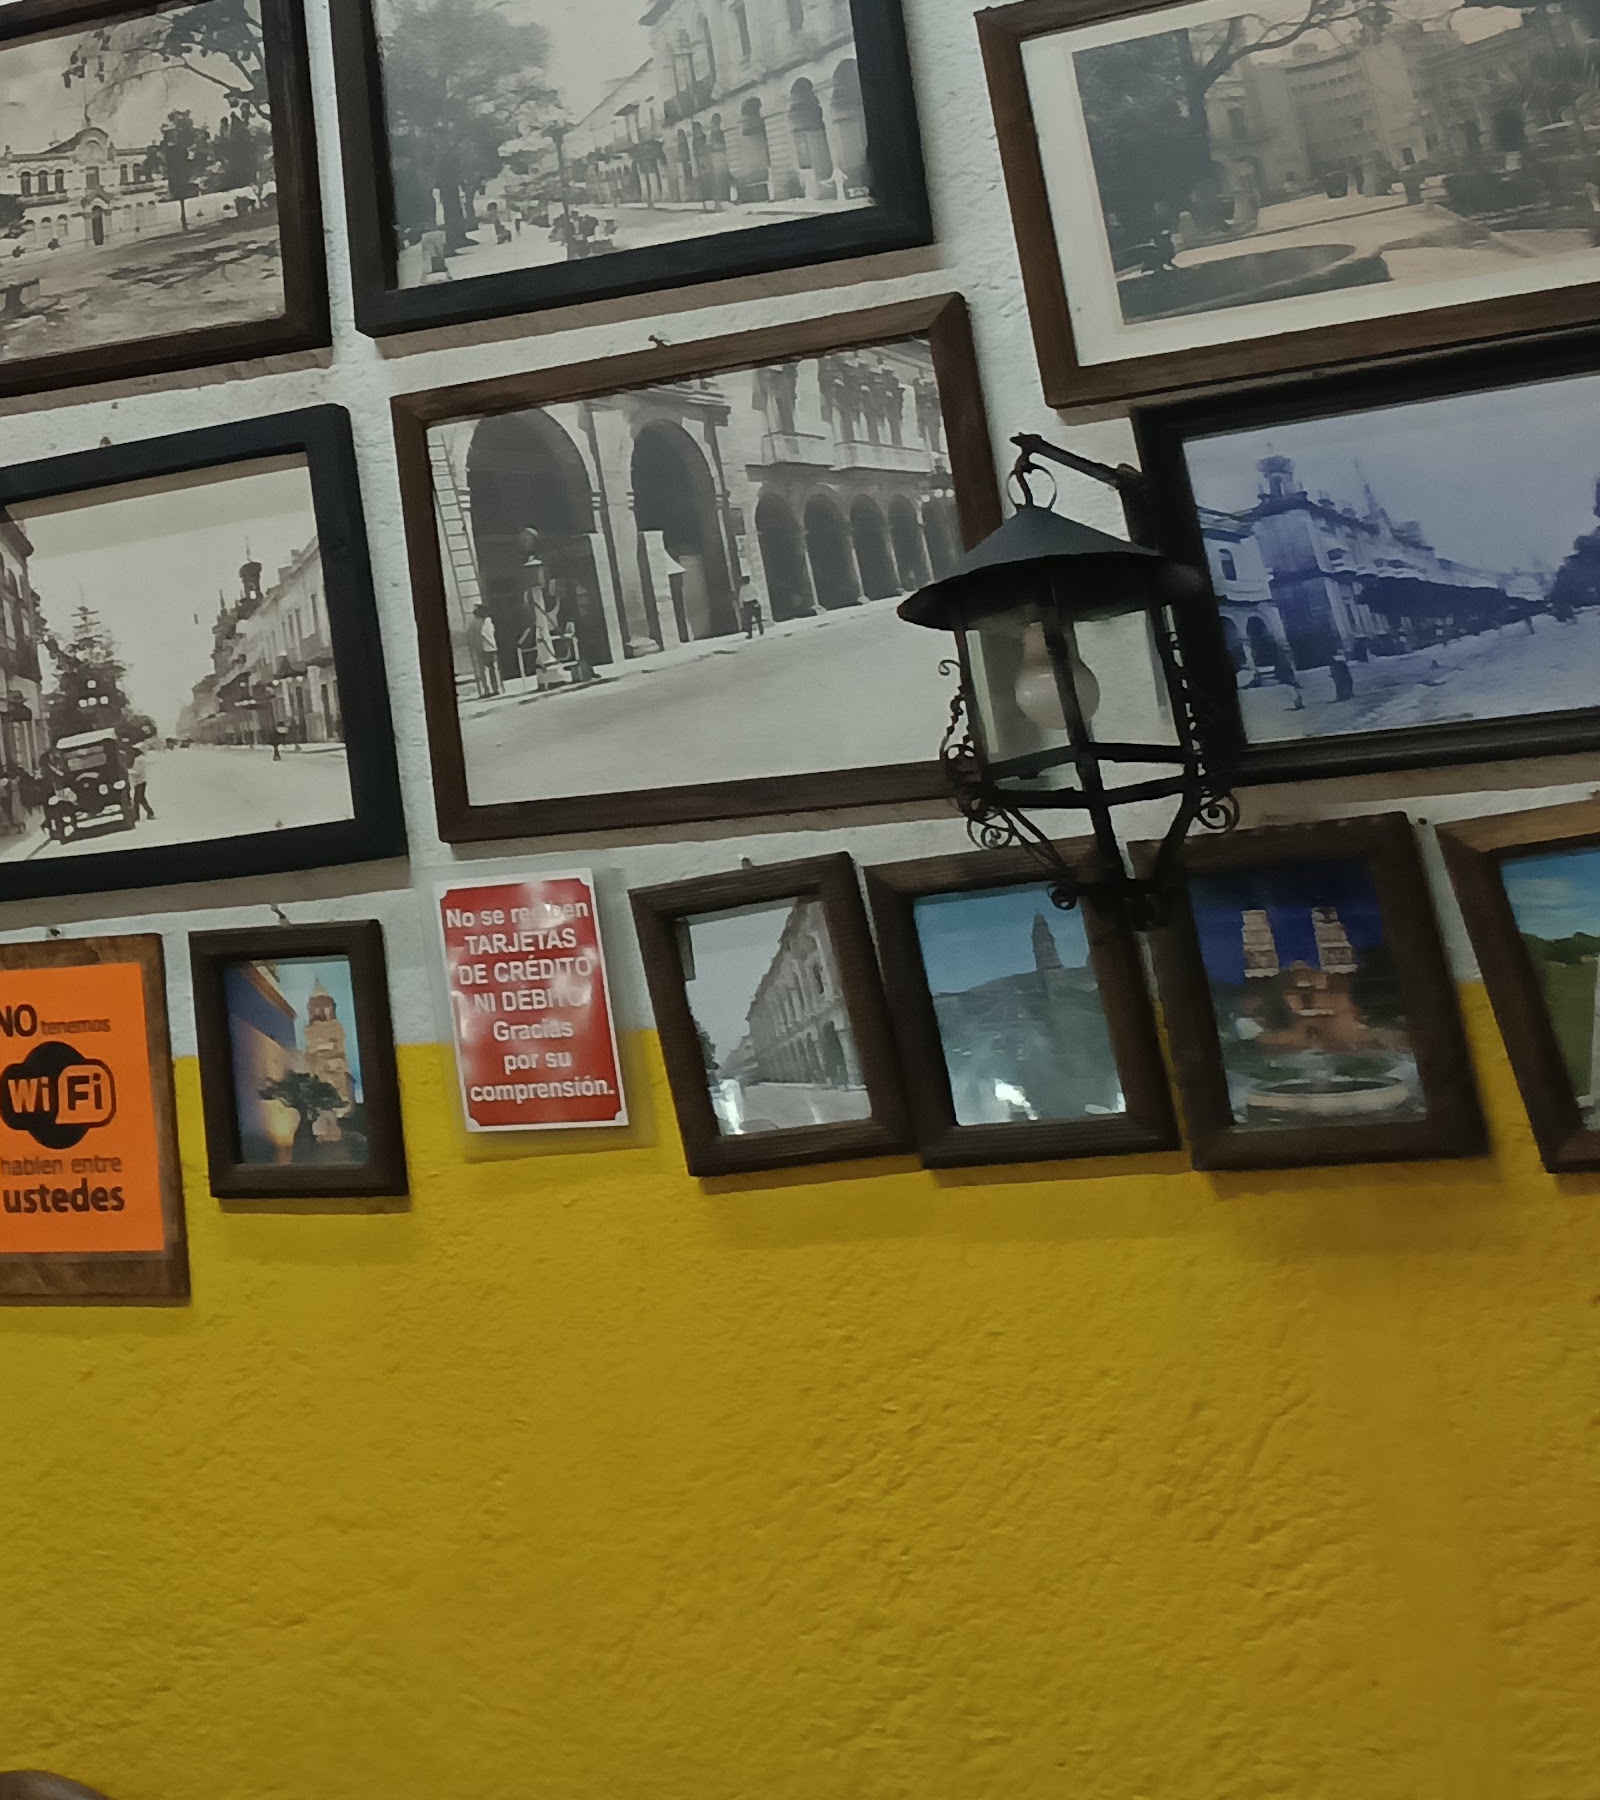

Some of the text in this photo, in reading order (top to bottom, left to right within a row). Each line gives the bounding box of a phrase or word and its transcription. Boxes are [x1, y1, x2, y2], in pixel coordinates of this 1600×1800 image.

[445, 908, 475, 928] No
[480, 909, 505, 926] se
[464, 927, 577, 956] TARJETAS
[458, 954, 593, 985] DE CRÉDITO
[473, 992, 496, 1012] NI
[41, 1017, 111, 1036] tenemos
[493, 1017, 575, 1042] Gracias
[503, 1051, 573, 1075] por su
[470, 1075, 616, 1104] comprensión.
[0, 1154, 123, 1177] hablen entre
[2, 1177, 126, 1214] ustedes
